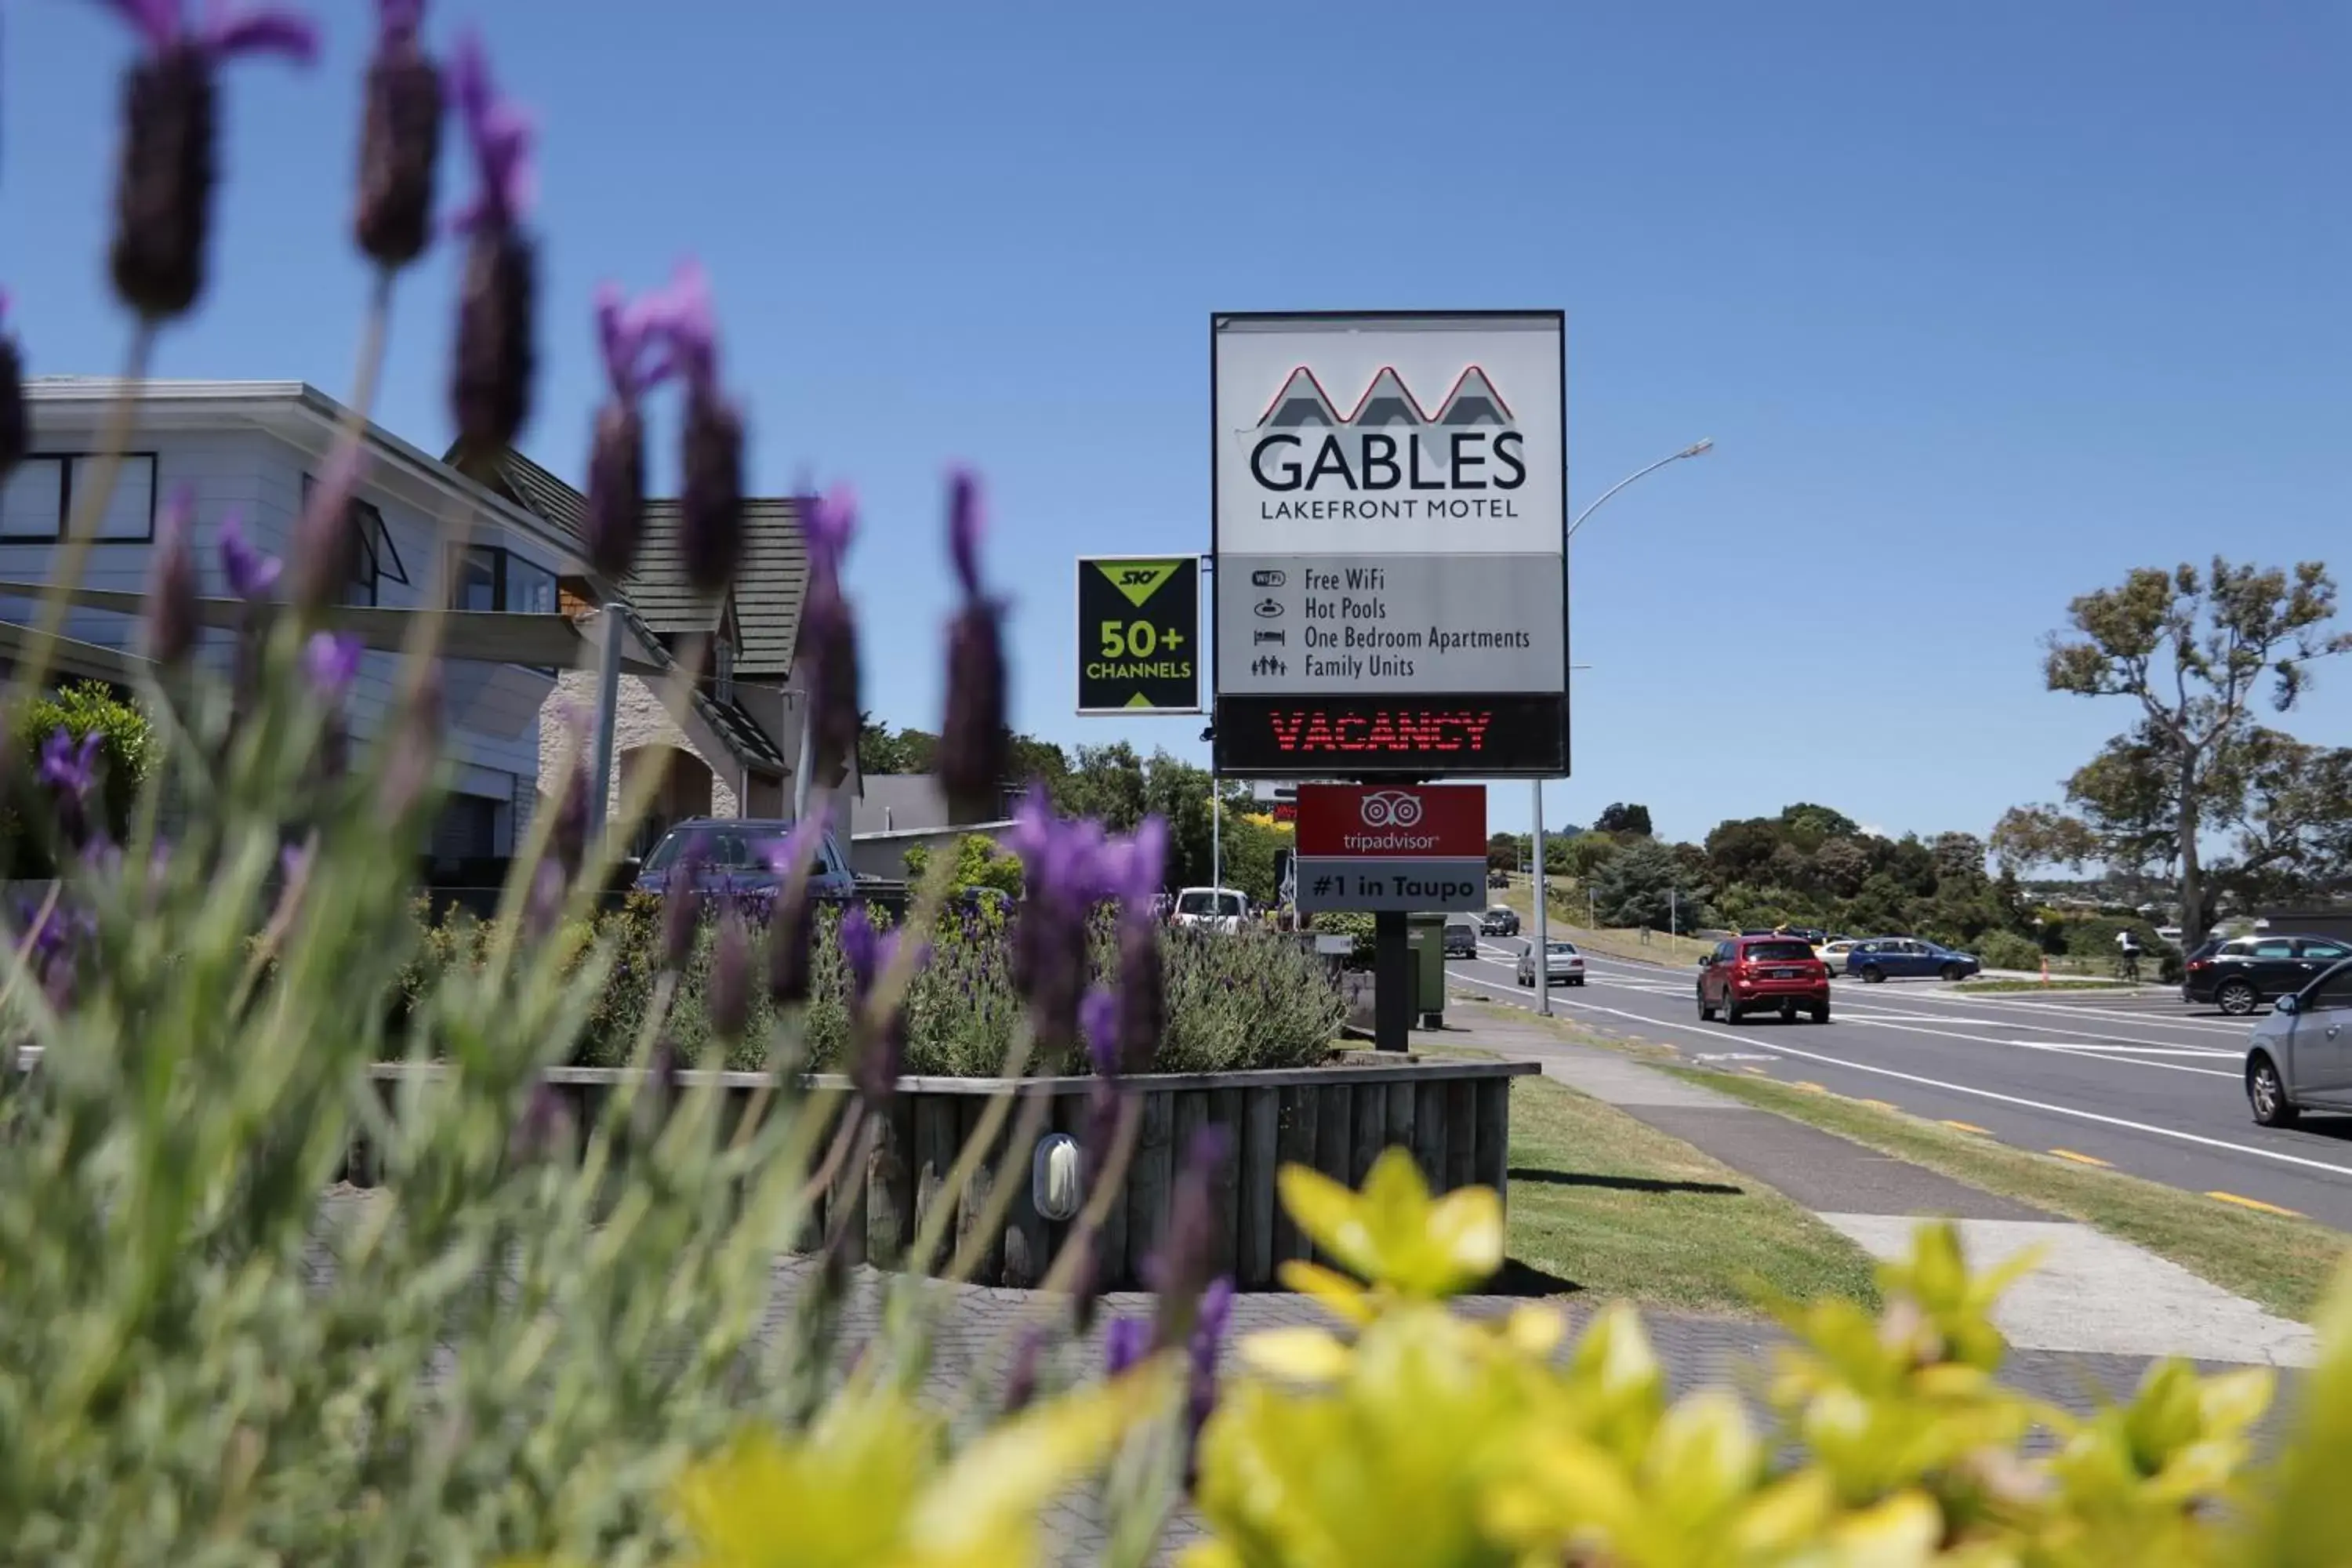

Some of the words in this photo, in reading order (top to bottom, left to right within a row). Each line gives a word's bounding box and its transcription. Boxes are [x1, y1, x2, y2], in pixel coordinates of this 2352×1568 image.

[1250, 431, 1526, 491] GABLES
[1261, 499, 1418, 519] LAKEFRONT
[1427, 499, 1519, 518] MOTEL
[1305, 568, 1340, 590] Free
[1345, 568, 1385, 590] WiFi
[1305, 597, 1335, 619] Hot
[1341, 597, 1385, 619] Pools
[1101, 620, 1184, 658] 50+
[1305, 626, 1338, 648] One
[1345, 626, 1421, 648] Bedroom
[1428, 626, 1530, 654] Apartments
[1086, 662, 1192, 679] CHANNELS
[1305, 655, 1363, 679] Family
[1369, 655, 1414, 677] Units
[1269, 712, 1492, 750] VACANCY
[1344, 833, 1434, 852] tripadvisor
[1312, 875, 1345, 897] #1
[1359, 875, 1383, 897] in
[1392, 876, 1475, 902] Taupo
